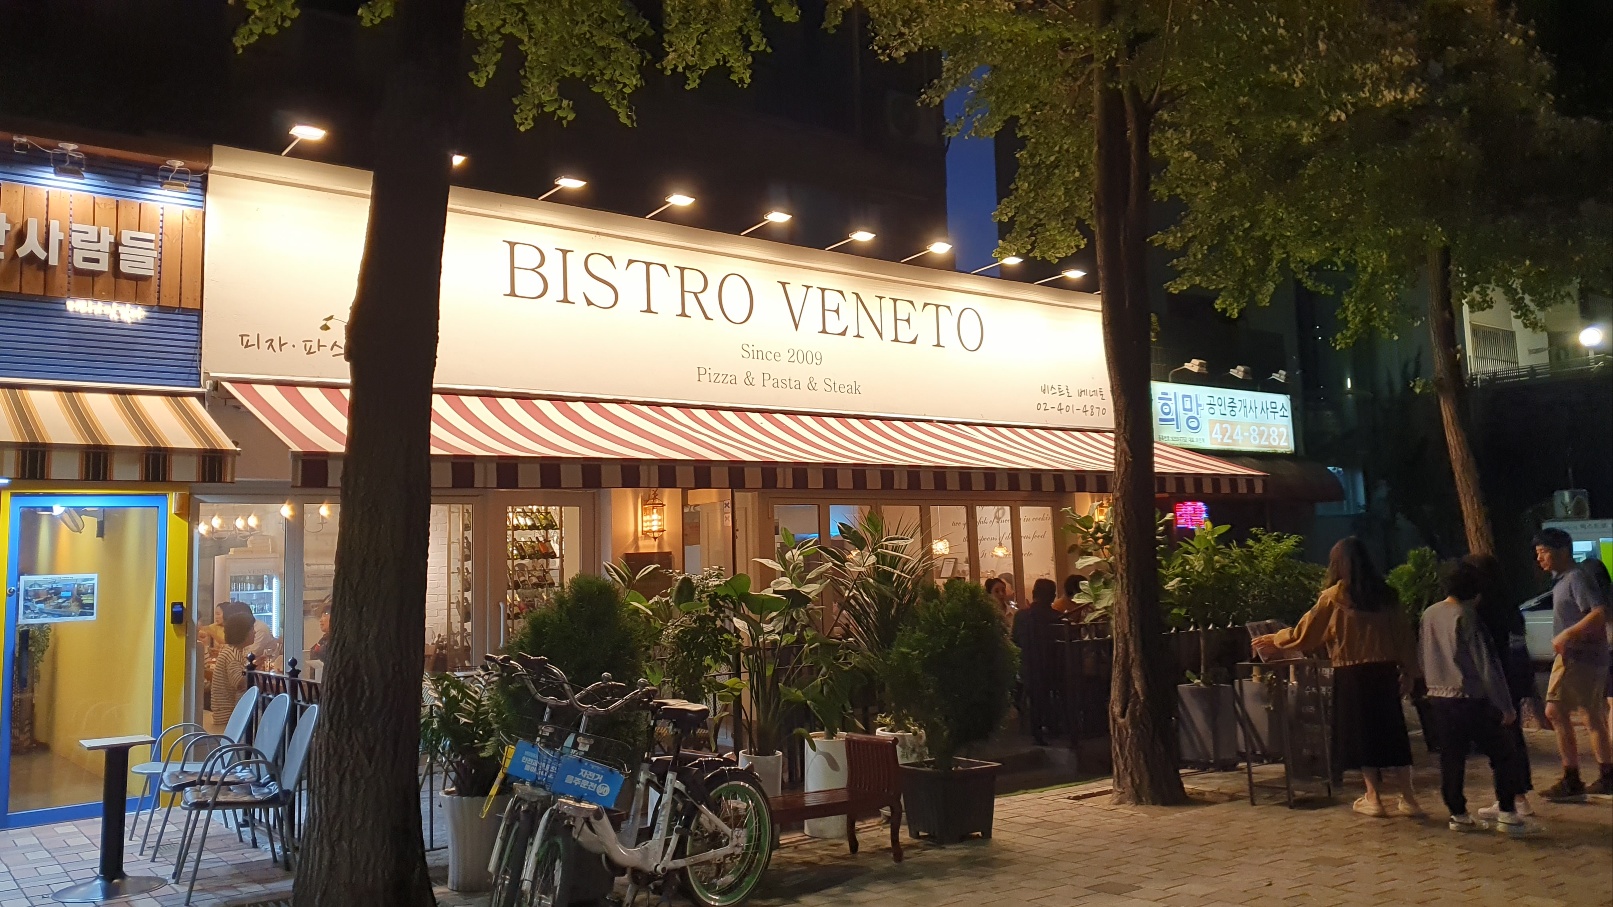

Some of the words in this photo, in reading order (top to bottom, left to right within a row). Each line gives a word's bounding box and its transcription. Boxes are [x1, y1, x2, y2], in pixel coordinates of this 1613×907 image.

[0, 213, 157, 276] 사람들
[502, 239, 754, 325] BISTRO
[776, 280, 984, 352] VENETO
[741, 343, 782, 362] Since
[787, 348, 823, 366] 2009
[697, 366, 737, 385] Pizza
[743, 370, 756, 387] &
[762, 372, 802, 390] Pasta
[807, 376, 819, 392] &
[823, 377, 862, 395] Steak
[1036, 402, 1107, 417] 02-401-4870
[1157, 391, 1205, 434] 희망
[1211, 422, 1288, 446] 424-8282
